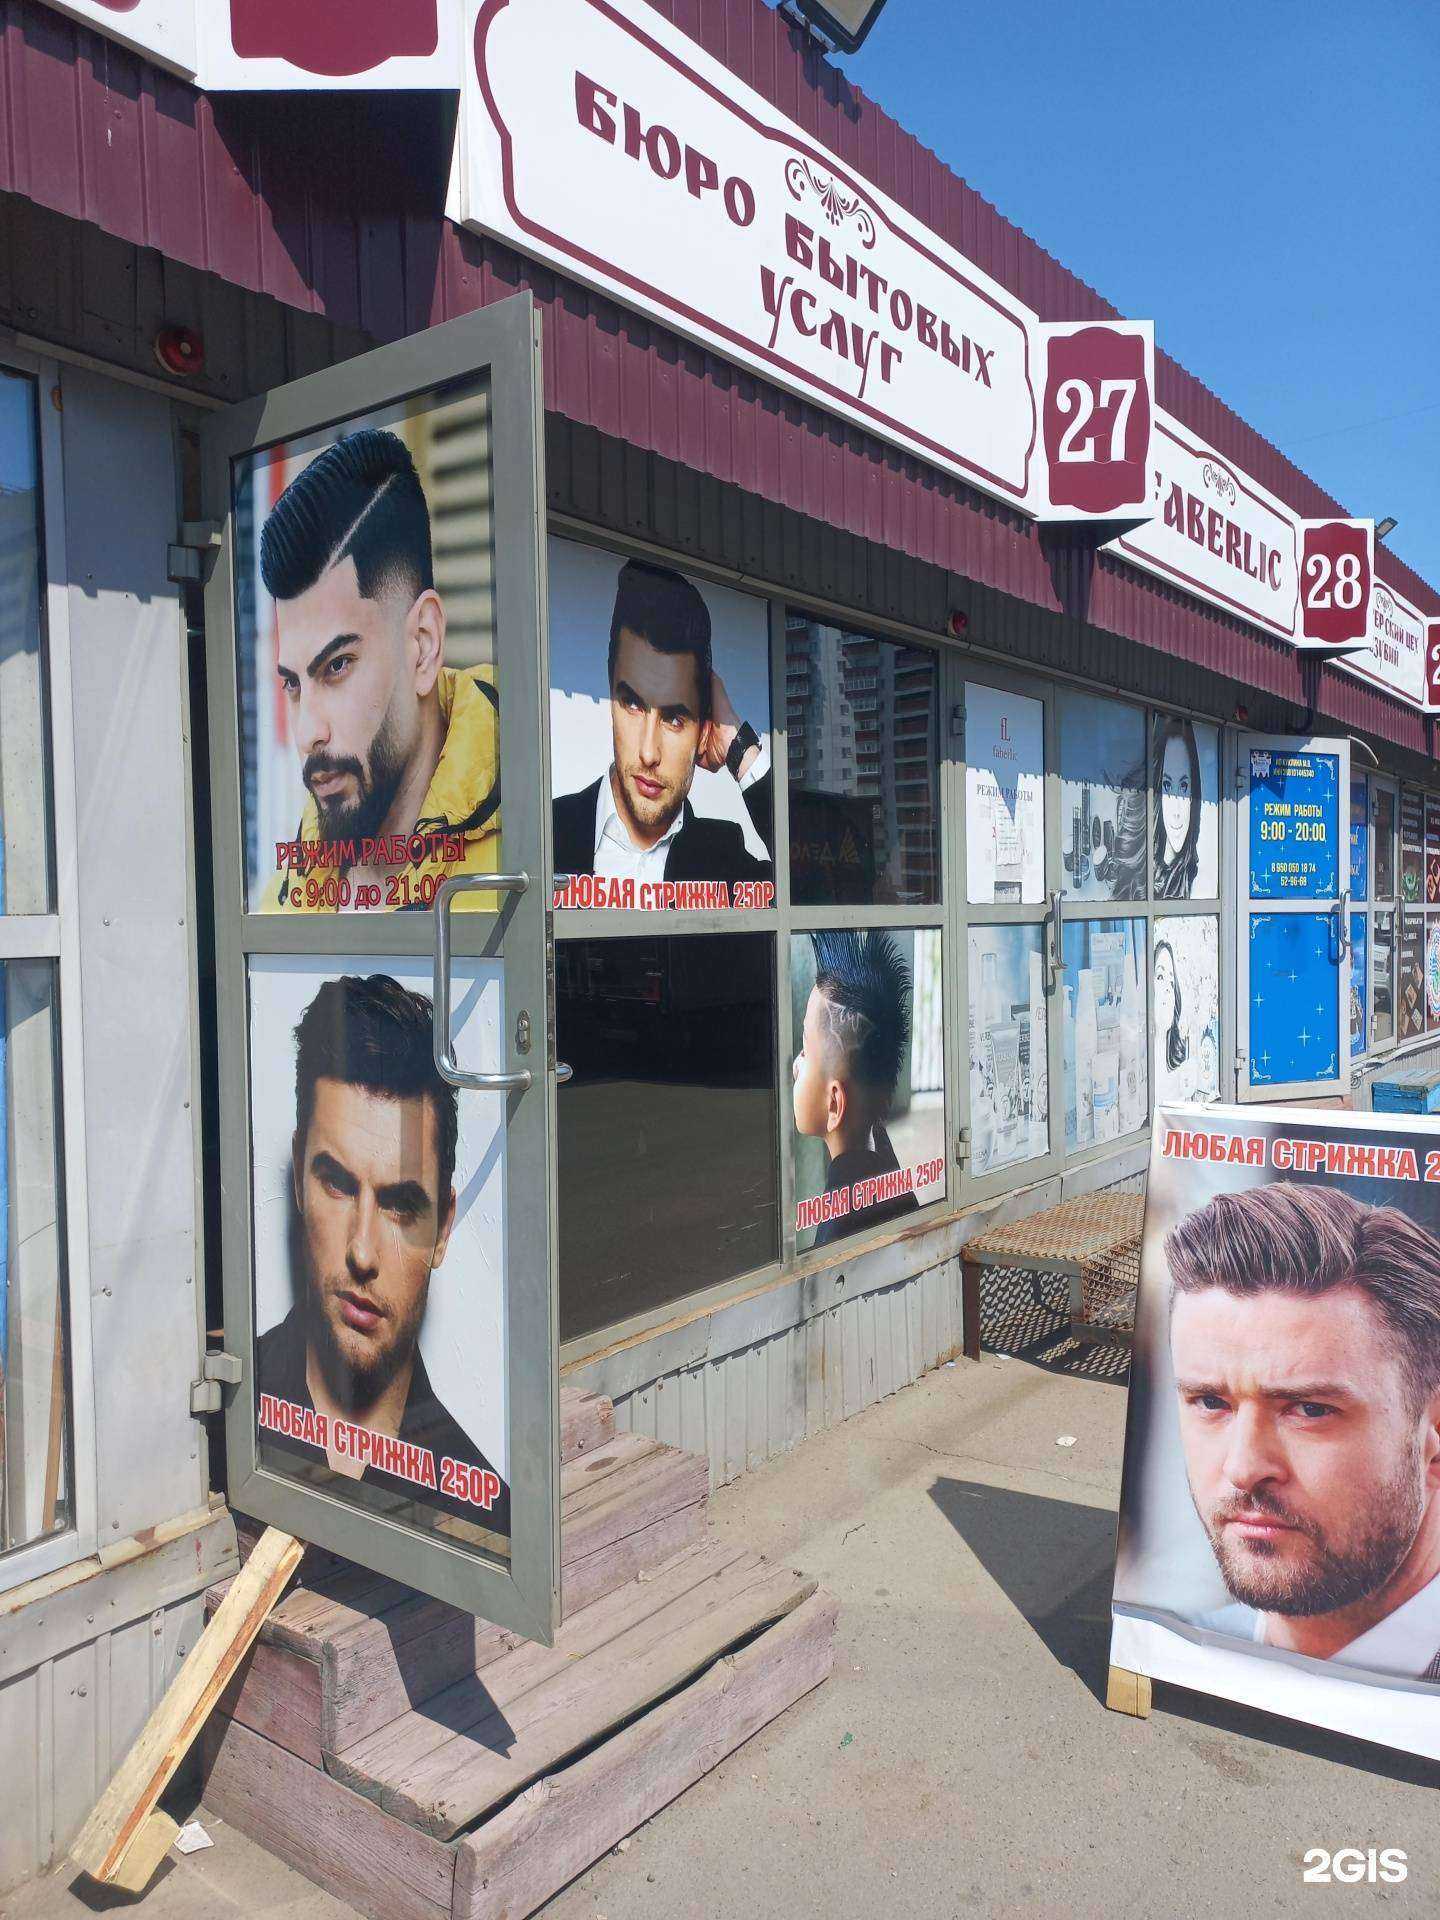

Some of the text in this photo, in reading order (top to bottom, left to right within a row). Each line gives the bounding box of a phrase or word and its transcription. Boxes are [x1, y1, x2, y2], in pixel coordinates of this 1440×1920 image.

[575, 70, 756, 227] БЮРО
[760, 264, 902, 399] УСЛУГ
[785, 213, 995, 389] БЫТОВЫХ
[1056, 378, 1137, 463] 27
[1155, 471, 1281, 591] ABERLIC
[1306, 553, 1362, 610] 28
[1261, 820, 1286, 840] 9:00
[1295, 822, 1326, 841] 20:00
[1264, 803, 1323, 818] РЕЖИМ РАБОТЫ
[275, 833, 466, 870] РЕЖИМ РАБОТЫ
[305, 878, 351, 907] 9:00
[355, 884, 382, 910] до
[639, 880, 730, 910] СТРИЖКА
[733, 880, 775, 909] 250Р
[1163, 1129, 1266, 1168] ЛЮБАЯ
[1272, 1138, 1419, 1181] СТРИЖКА
[796, 1157, 944, 1231] ЛЮБАЯ СТРИЖКА 250Р
[260, 1393, 501, 1511] ЛЮБАЯ СТРИЖКА 250Р
